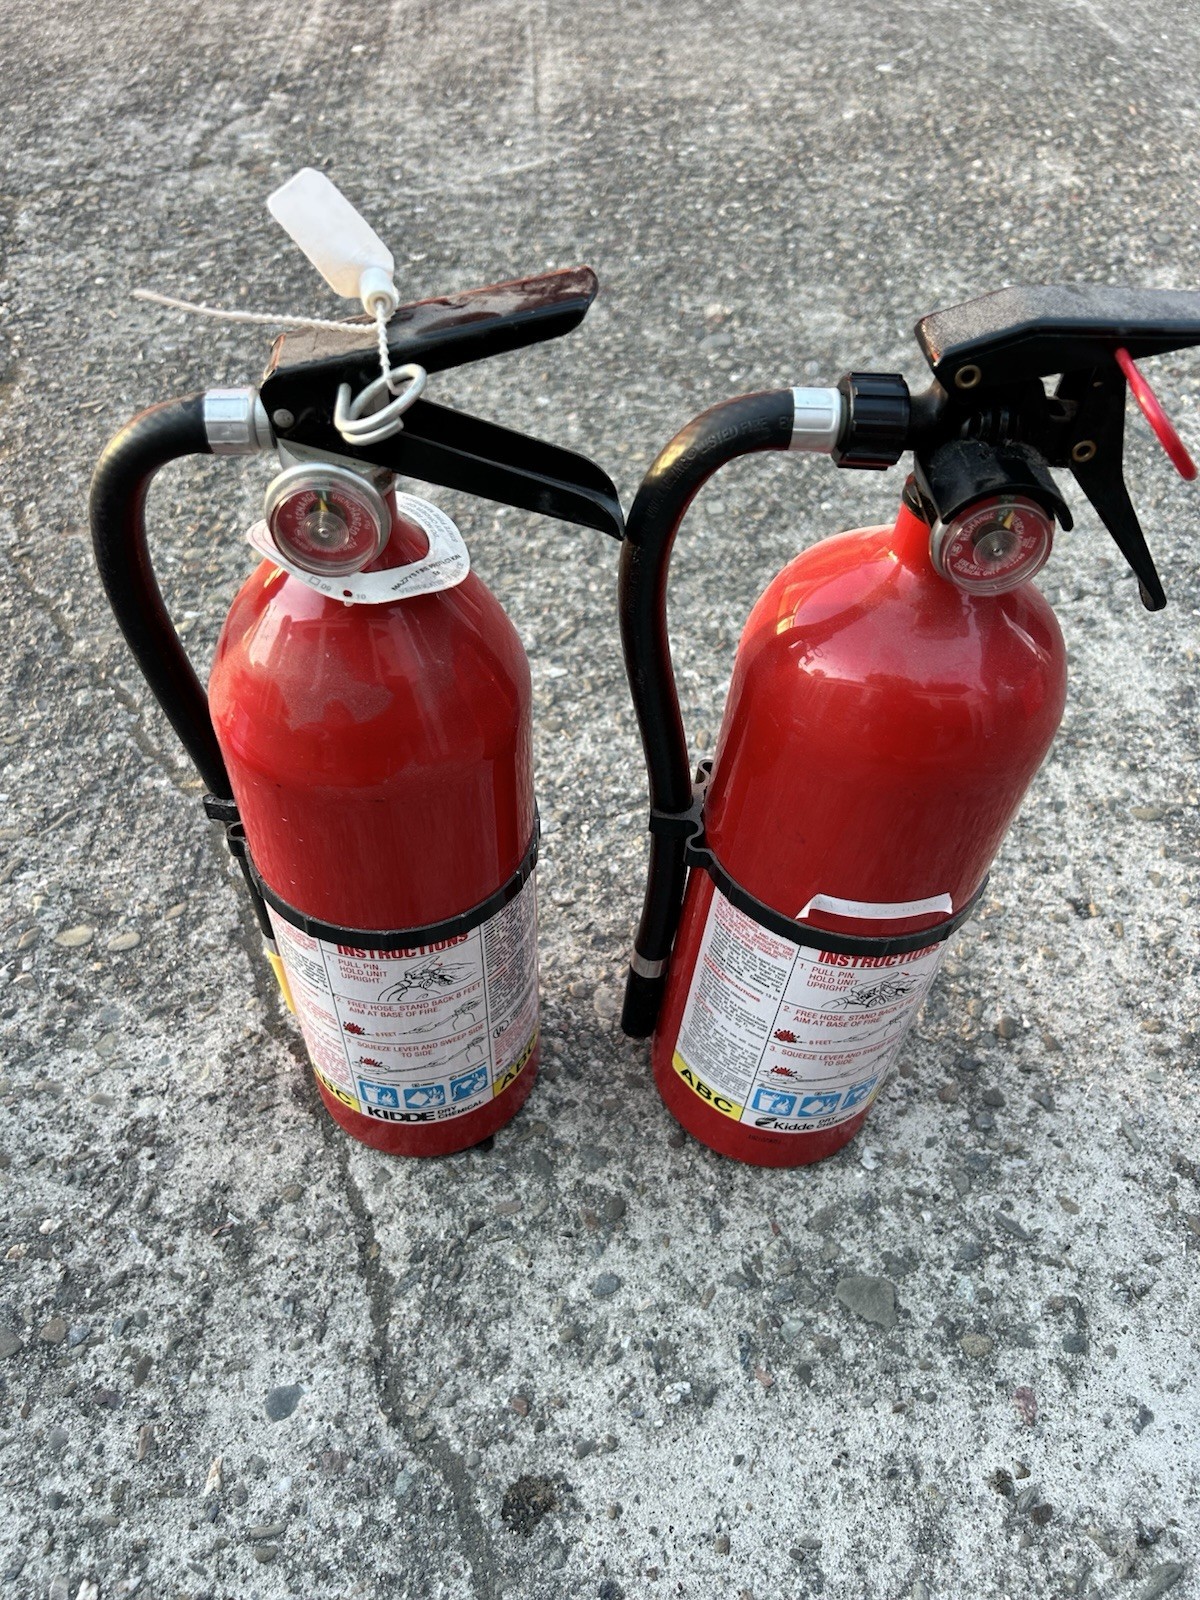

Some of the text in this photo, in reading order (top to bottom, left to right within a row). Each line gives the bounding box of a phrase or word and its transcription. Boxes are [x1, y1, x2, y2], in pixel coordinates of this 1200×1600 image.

[338, 958, 360, 968] PULL
[340, 966, 363, 975] HOLD
[812, 966, 835, 978] PULL
[838, 971, 856, 979] PIN.
[341, 972, 383, 984] UPRIGHT.
[809, 974, 859, 986] HOLD UNIT
[347, 1000, 368, 1010] FREE
[399, 1002, 429, 1011] STAND
[431, 995, 455, 1006] BACK
[463, 982, 482, 996] FEET
[349, 1006, 365, 1016] AIM
[380, 1010, 405, 1018] BASE
[407, 1010, 417, 1018] OF
[419, 1006, 441, 1016] FIRE.
[795, 1009, 818, 1020] FREE
[848, 1012, 877, 1021] STAND
[878, 1007, 897, 1016] BACK
[793, 1016, 811, 1026] AIM
[826, 1020, 849, 1028] BASE
[850, 1019, 861, 1027] OF
[357, 1041, 391, 1052] SQUEEZE
[421, 1043, 438, 1051] AND
[440, 1033, 467, 1047] SWEEP
[468, 1024, 485, 1036] SIDE
[781, 1050, 816, 1061] SQUEEZE
[818, 1053, 844, 1061] LEVER
[845, 1051, 861, 1059] AND
[681, 1068, 733, 1113] ABC
[367, 1105, 437, 1122] KIDDE
[437, 1106, 457, 1114] DRY
[438, 1100, 483, 1119] CHEMICAL
[818, 1115, 837, 1124] DRY
[773, 1121, 815, 1131] Kidde
